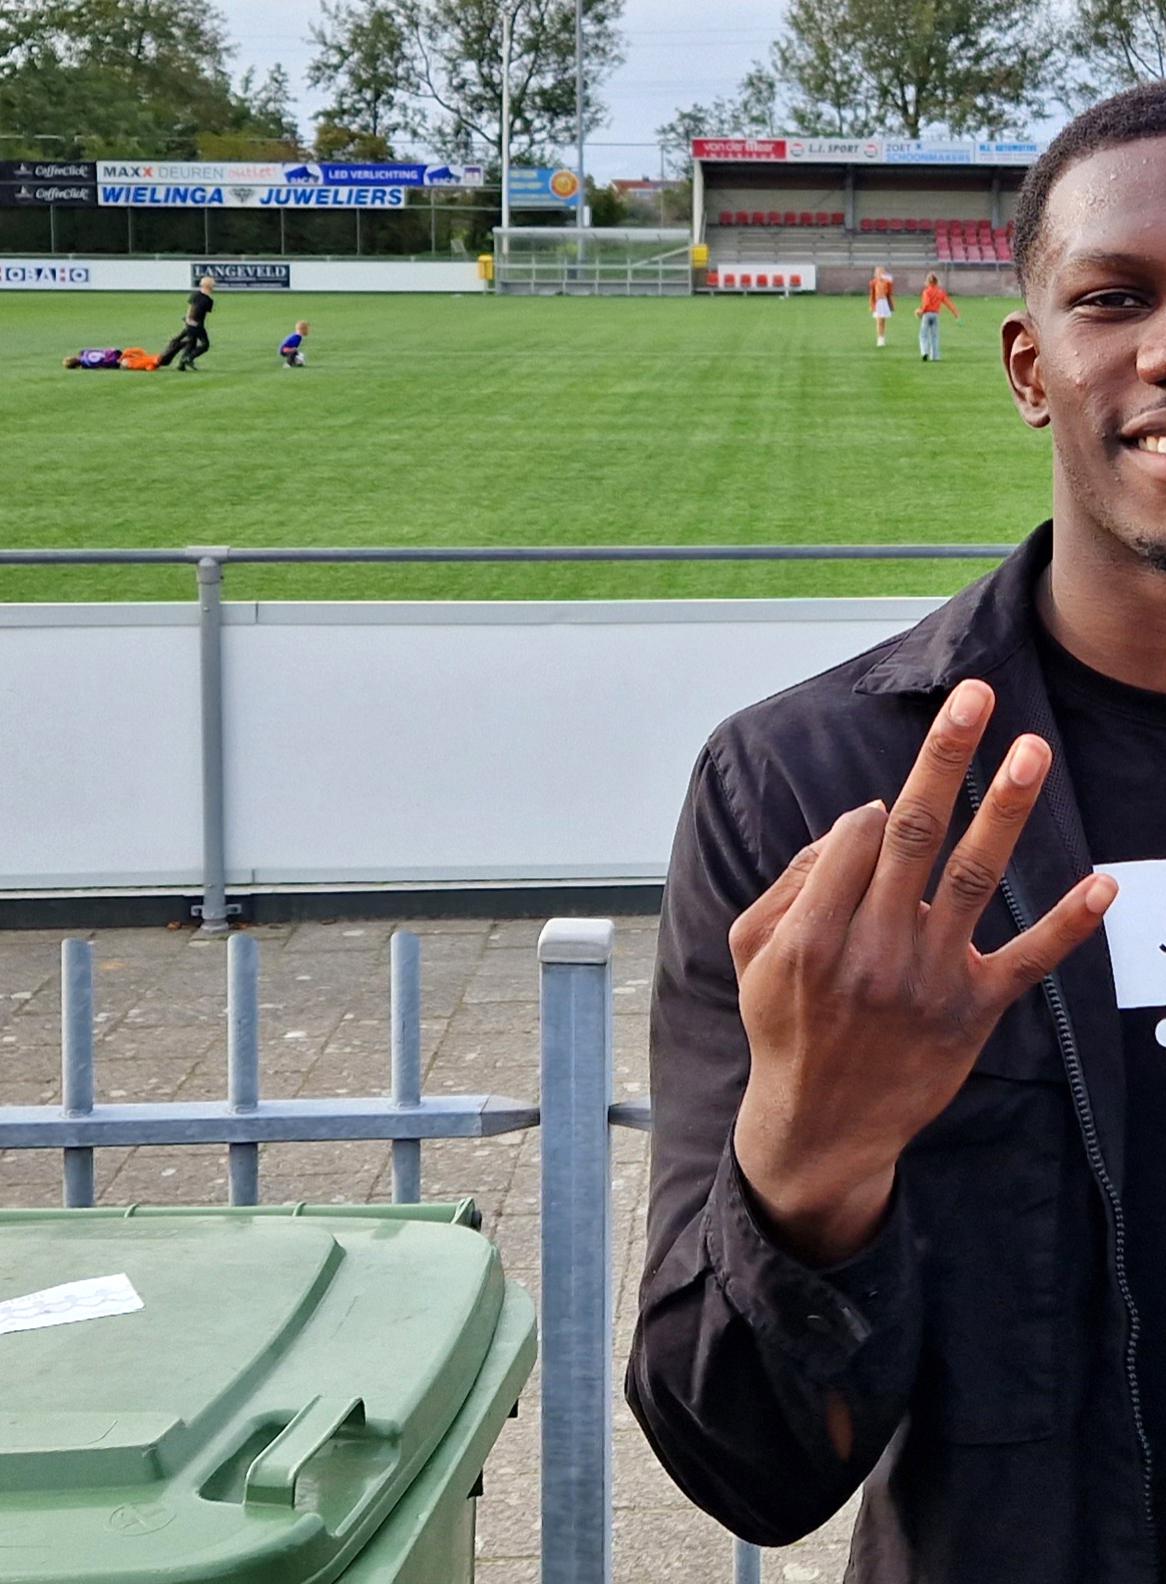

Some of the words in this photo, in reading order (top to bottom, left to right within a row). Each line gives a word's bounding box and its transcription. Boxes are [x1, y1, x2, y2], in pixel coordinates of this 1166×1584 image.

[828, 144, 860, 154] SPORT
[886, 143, 911, 152] ZOET
[103, 166, 154, 178] MAXX
[158, 167, 224, 179] DEUREN
[328, 170, 348, 180] LED
[350, 170, 418, 180] VERLICHTING
[102, 187, 224, 205] WIELINGA
[259, 188, 403, 207] JUWELIERS
[194, 265, 287, 278] LANGEVELD
